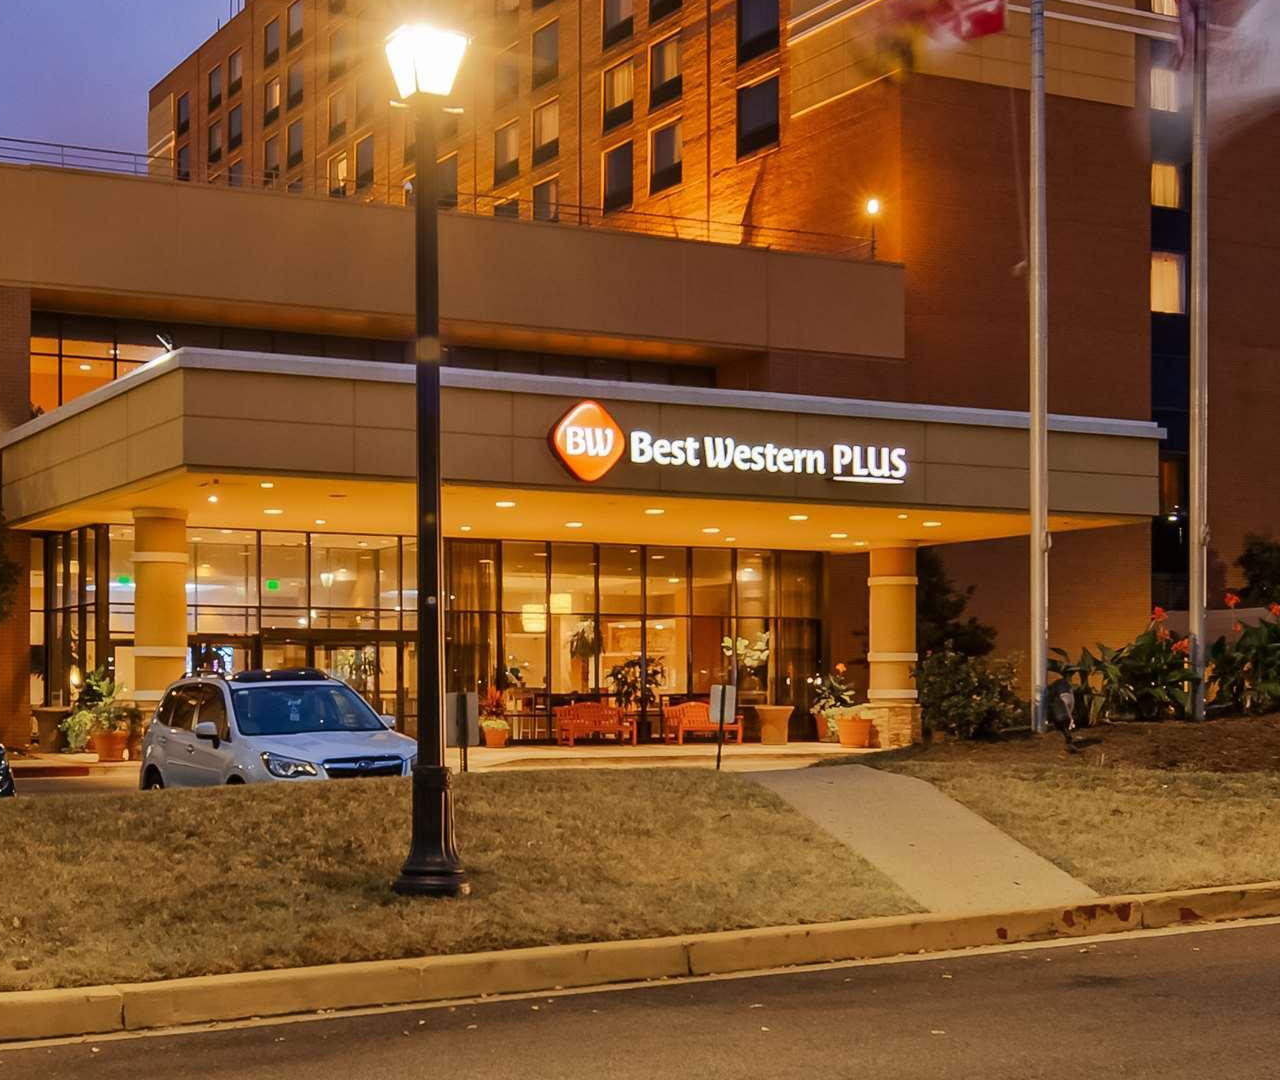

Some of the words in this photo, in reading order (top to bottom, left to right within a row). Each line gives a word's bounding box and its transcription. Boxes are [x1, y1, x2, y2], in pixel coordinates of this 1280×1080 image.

[565, 425, 615, 457] BW
[630, 430, 701, 467] Best
[704, 436, 827, 475] Western
[832, 443, 908, 478] PLUS
